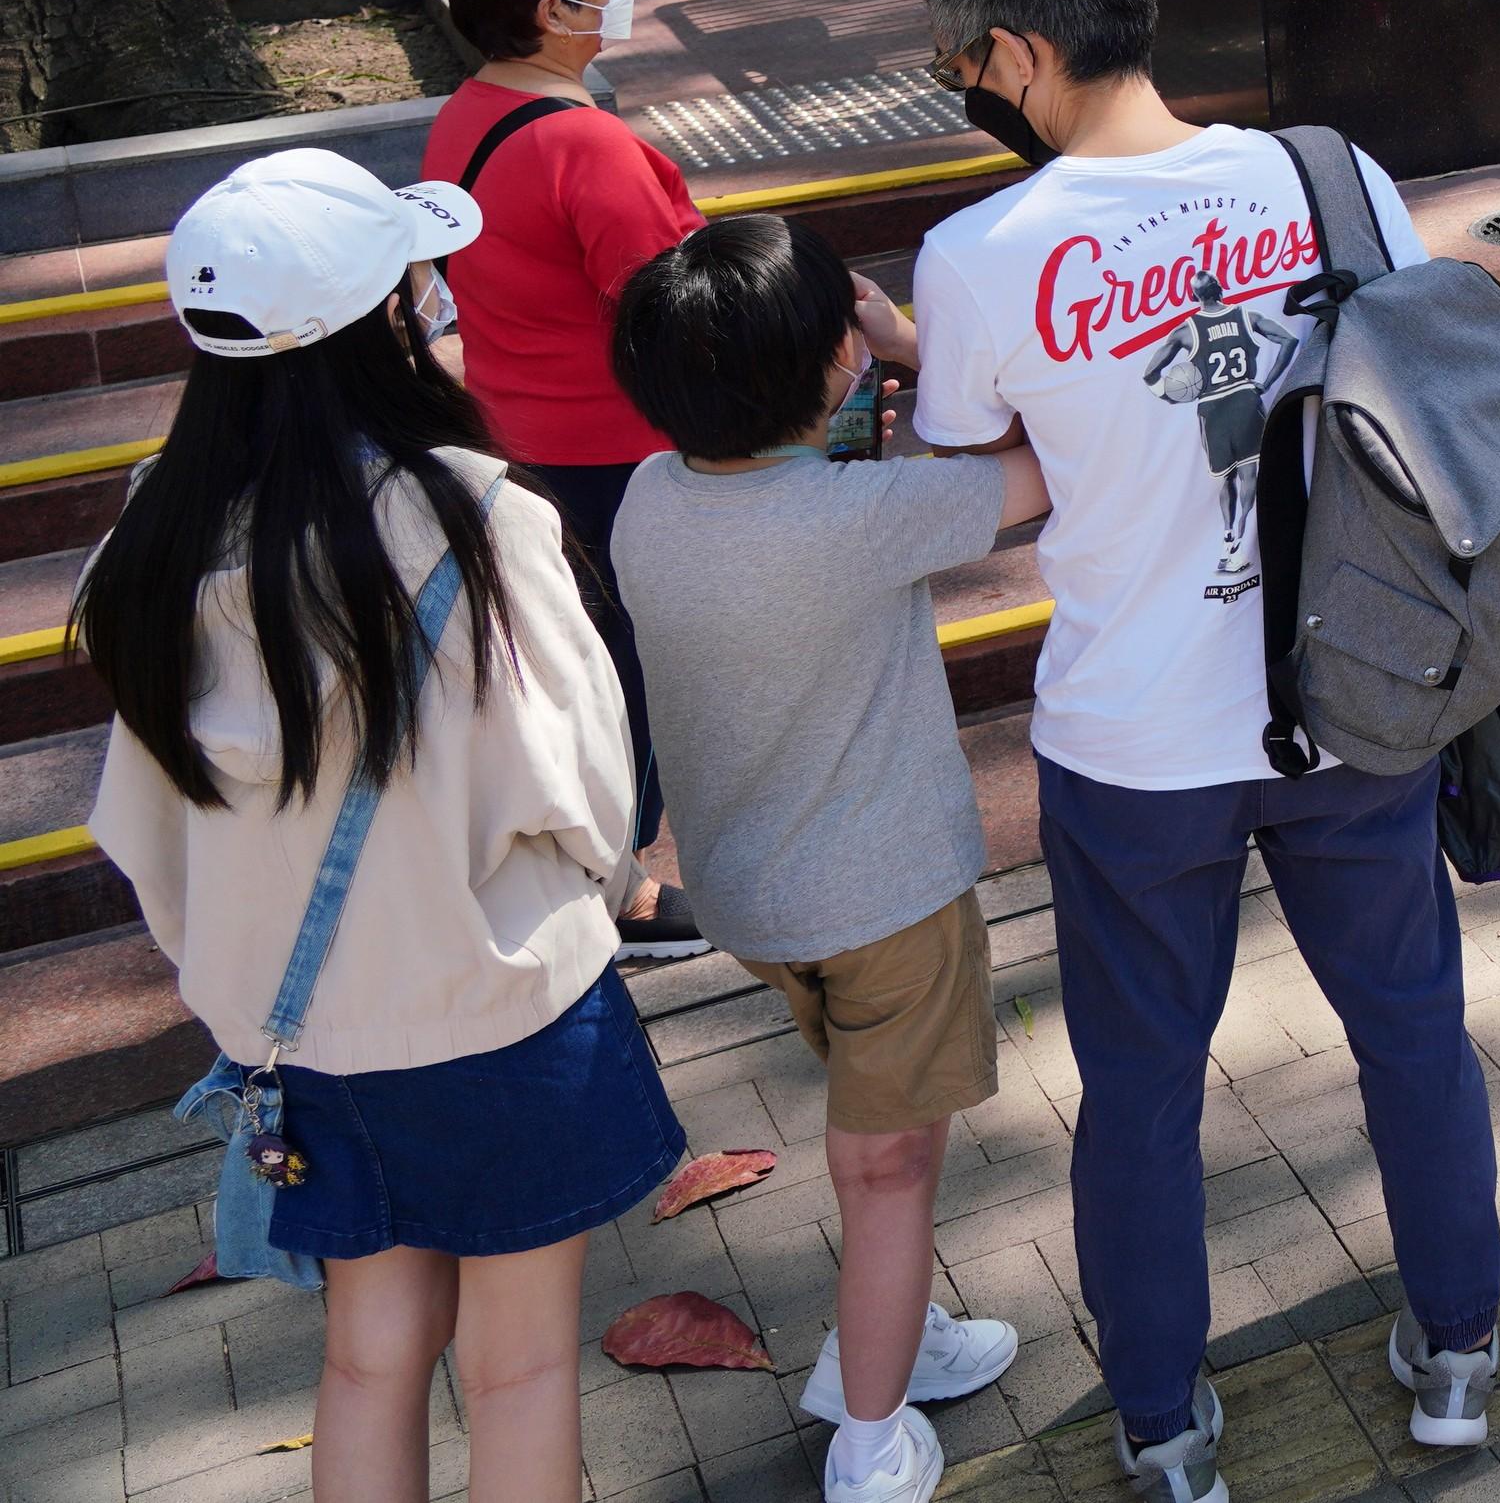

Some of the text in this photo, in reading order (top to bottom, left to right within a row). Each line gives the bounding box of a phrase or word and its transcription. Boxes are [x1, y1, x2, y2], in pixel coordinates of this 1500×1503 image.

[418, 201, 461, 229] LOS
[1113, 198, 1269, 252] IN THE MIDST OF
[1035, 217, 1321, 362] Greatness
[1207, 321, 1240, 342] JORDAN
[1208, 346, 1247, 385] 23
[1205, 577, 1258, 596] AIR JORDAN
[1226, 594, 1237, 603] 23
